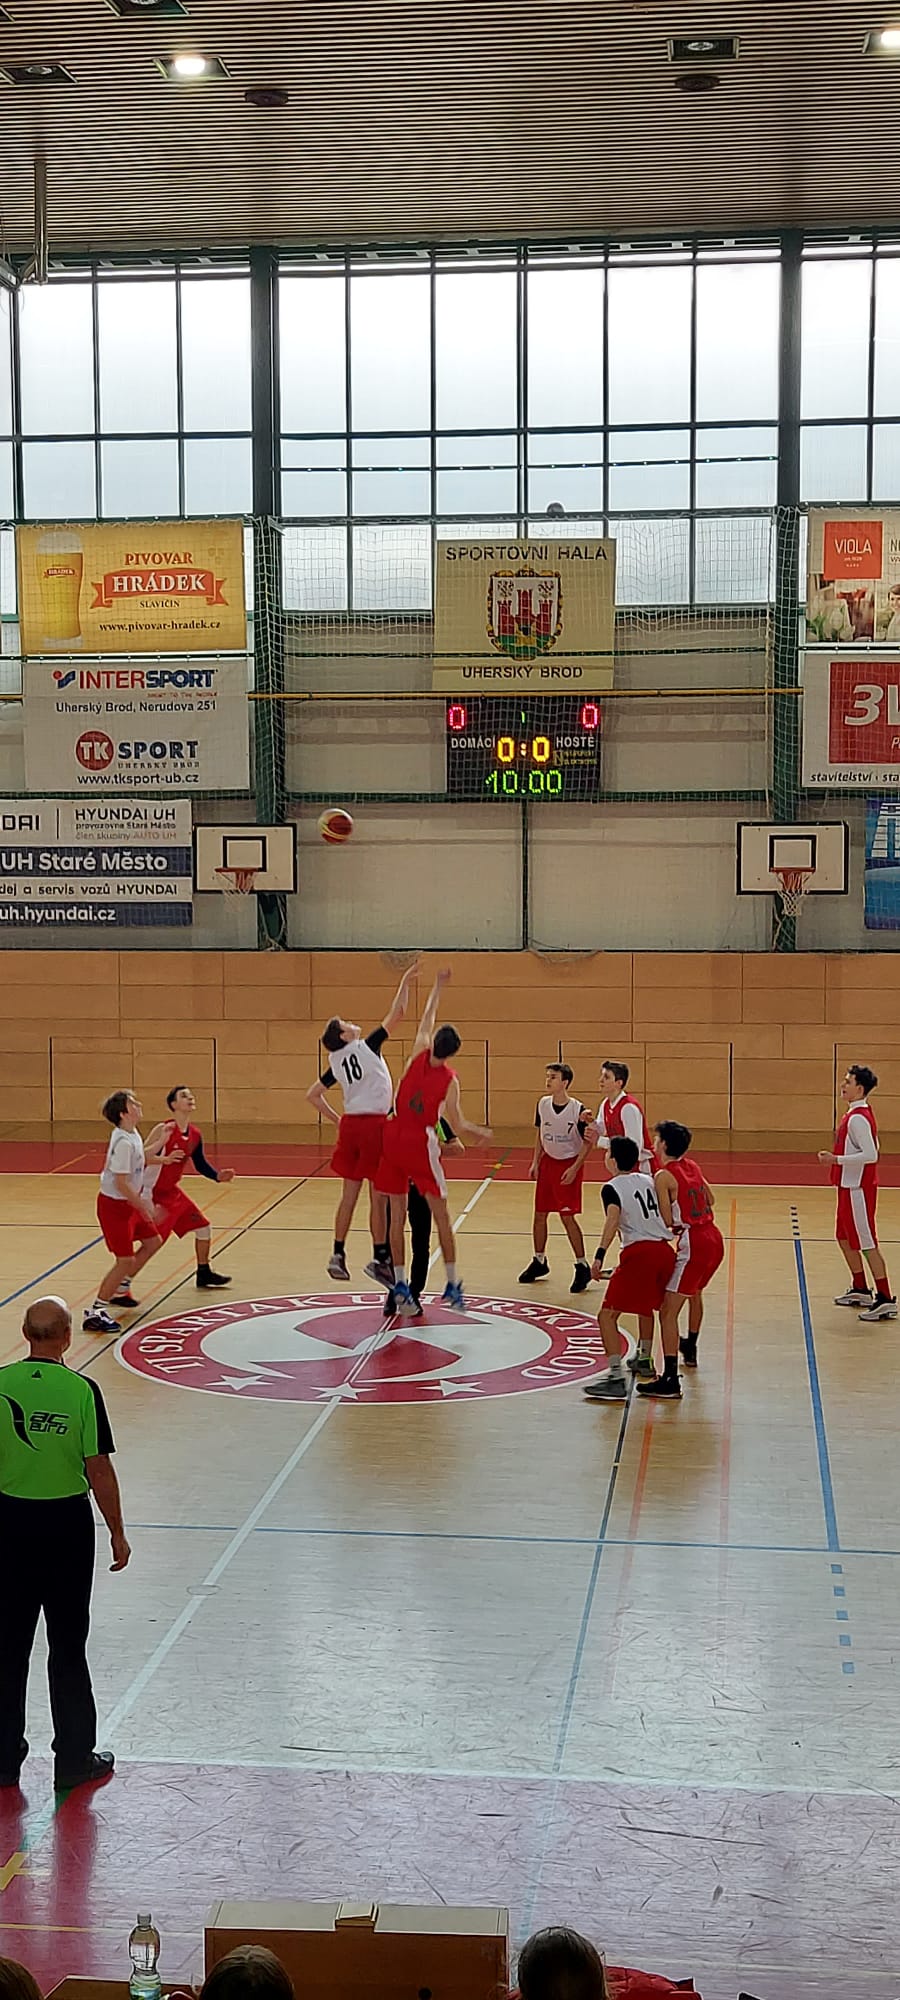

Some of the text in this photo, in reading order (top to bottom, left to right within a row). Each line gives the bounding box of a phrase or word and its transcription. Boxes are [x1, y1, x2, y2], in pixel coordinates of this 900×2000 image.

[558, 546, 607, 560] HALA
[834, 538, 872, 554] VIOLA
[125, 552, 193, 565] PIVOVAR
[112, 572, 206, 593] HRÁDEK
[100, 620, 221, 633] www.pivovar-hradek.cz
[80, 670, 215, 689] INTERSPORT
[540, 666, 583, 678] BROD
[56, 700, 216, 714] Uherský Brod, Nerudova 251
[449, 706, 465, 730] 0
[582, 704, 598, 729] 0
[78, 741, 198, 760] TK SPORT
[497, 736, 550, 763] 0:0
[78, 773, 199, 786] www.tksport-ub.cz
[810, 771, 872, 782] stavitelství
[75, 808, 176, 820] HYUNDAI UH
[1, 850, 168, 871] UH Staré Město
[23, 886, 32, 895] a
[38, 883, 75, 895] servis
[80, 883, 110, 895] vozů
[116, 884, 177, 895] HYUNDAI
[341, 1053, 362, 1085] 18
[567, 1122, 574, 1134] 7
[633, 1187, 659, 1219] 14
[138, 1296, 338, 1353] SPARTAK
[520, 1336, 606, 1380] BROD
